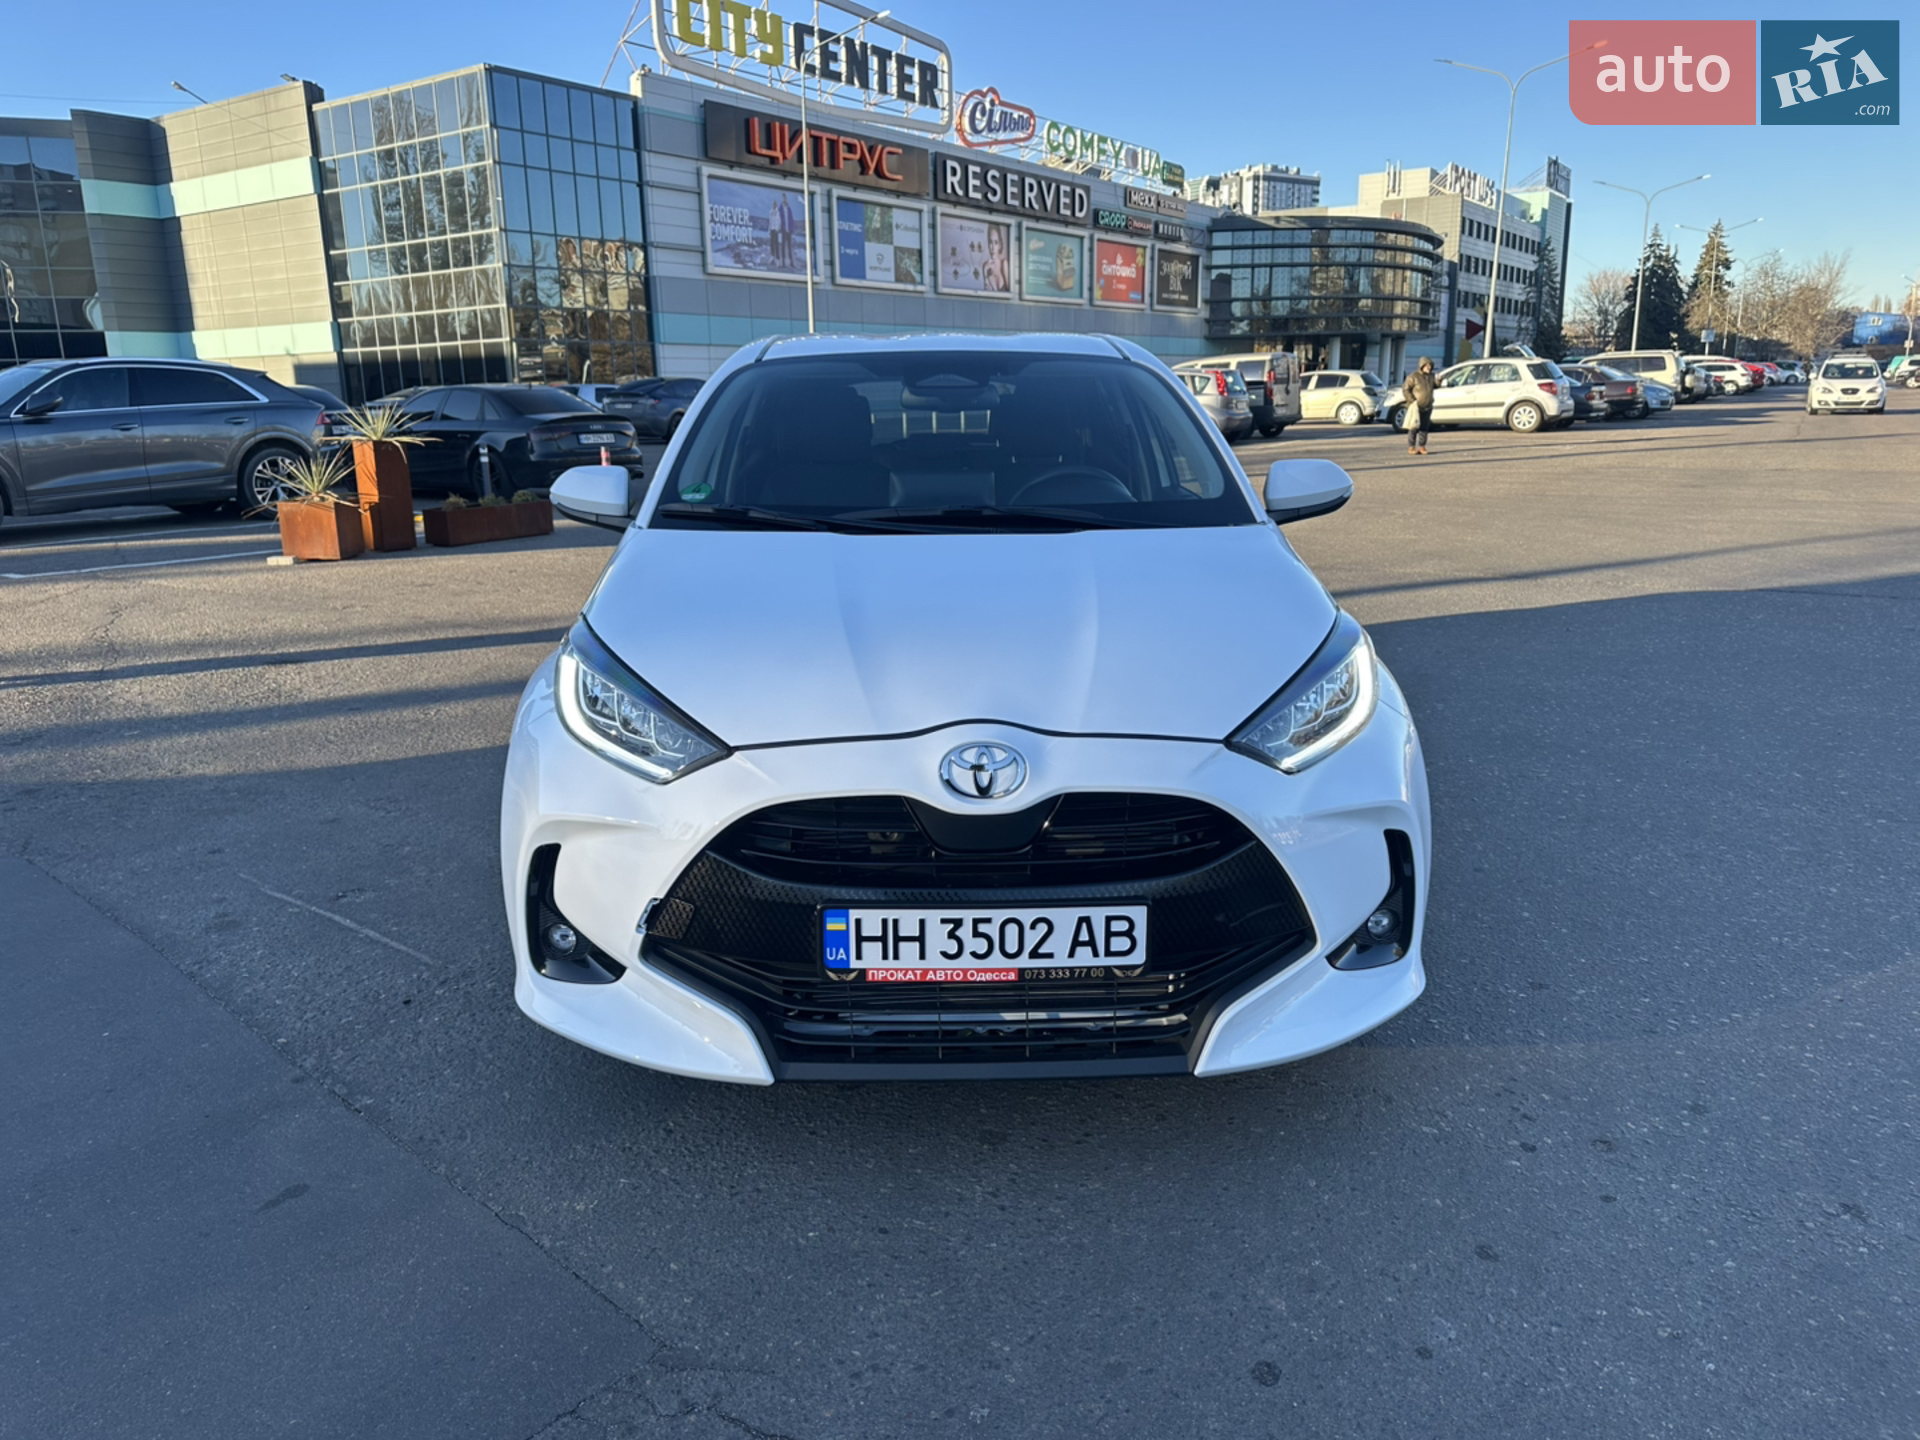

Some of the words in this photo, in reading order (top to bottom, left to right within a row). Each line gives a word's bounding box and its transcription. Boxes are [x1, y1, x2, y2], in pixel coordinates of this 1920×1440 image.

[673, 0, 784, 66] CITY
[790, 22, 940, 109] CENTER
[749, 117, 903, 181] ЦИТРУС
[945, 160, 1088, 219] RESERVED
[708, 203, 753, 226] FOREVER.
[1098, 210, 1126, 229] CROPP
[709, 221, 757, 245] COMFORT.
[855, 918, 926, 961] HH
[939, 916, 1055, 961] 3502
[1067, 915, 1138, 958] AB
[826, 947, 847, 960] UA
[868, 970, 922, 981] ПРОКАТ
[926, 970, 963, 981] АВТО
[967, 969, 1016, 982] Одесса
[1024, 969, 1046, 979] 073
[1049, 968, 1070, 979] 333
[1073, 968, 1086, 978] 77
[1090, 967, 1105, 978] 00
